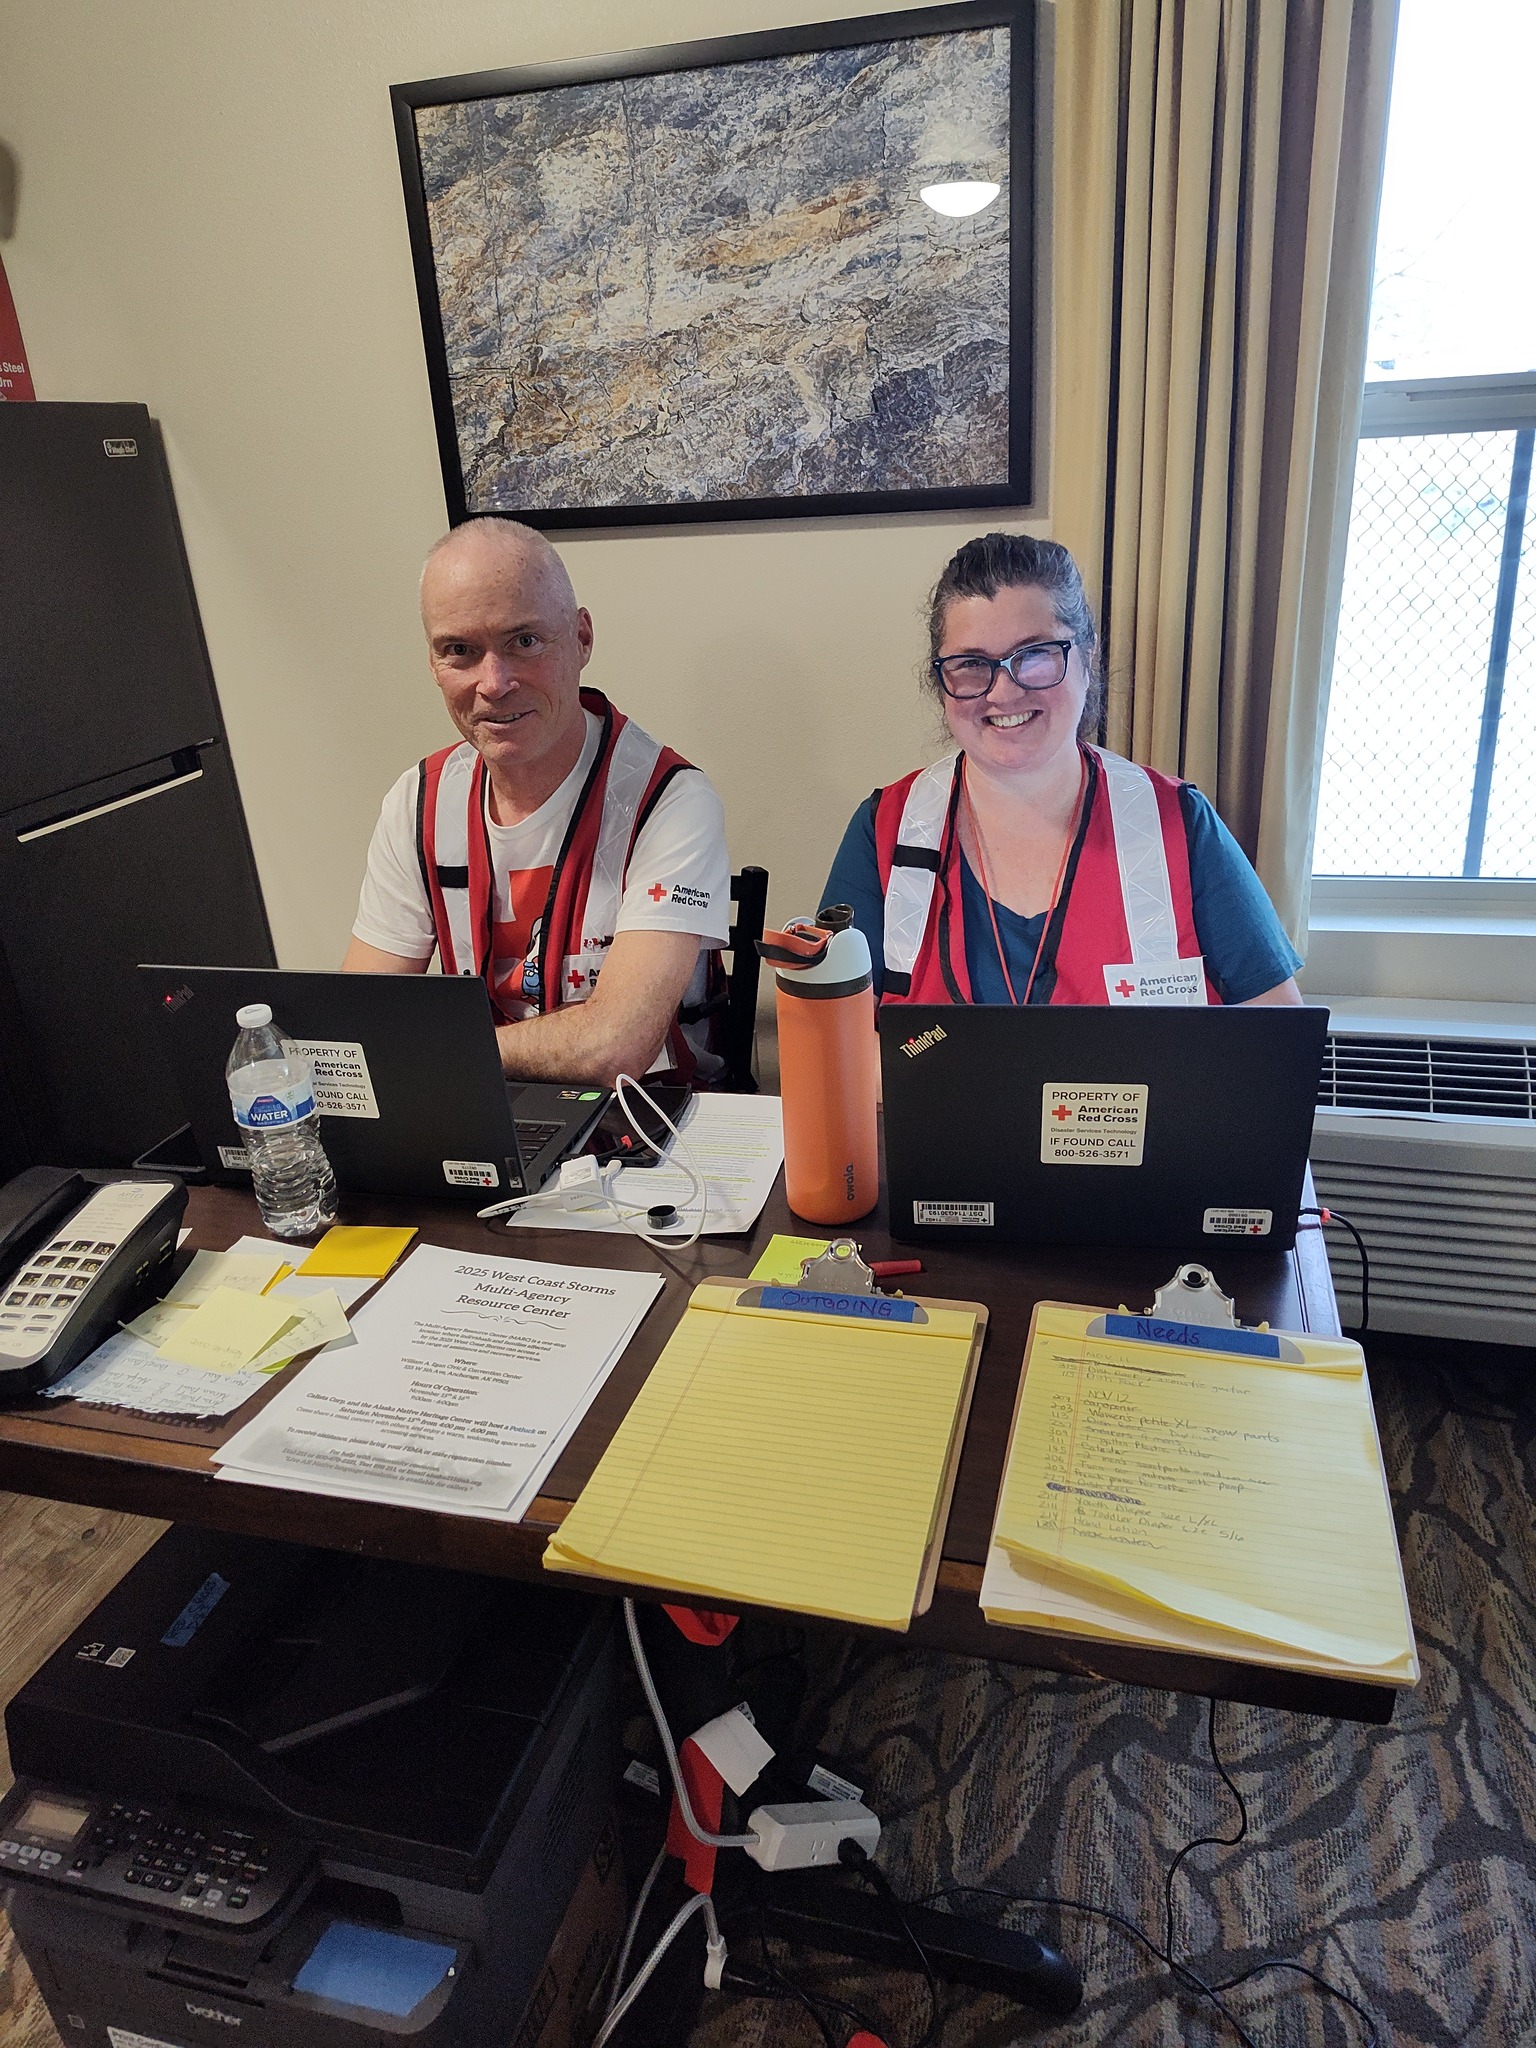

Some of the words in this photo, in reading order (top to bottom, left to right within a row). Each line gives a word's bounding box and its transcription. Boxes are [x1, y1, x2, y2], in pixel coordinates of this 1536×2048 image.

[2, 362, 25, 373] Steel
[672, 884, 711, 900] American
[671, 894, 687, 906] Red
[688, 897, 709, 909] Cross
[1139, 973, 1199, 987] American
[1140, 987, 1162, 998] Red
[1164, 984, 1199, 996] Cross
[900, 1024, 948, 1059] ThinkPad
[289, 1047, 340, 1058] PROPERTY
[344, 1050, 357, 1058] OF
[314, 1060, 361, 1070] American
[335, 1070, 363, 1078] Cross
[316, 1090, 344, 1099] OUND
[346, 1092, 369, 1101] CALL
[1052, 1092, 1119, 1101] PROPERTY
[1122, 1093, 1140, 1101] OF
[317, 1101, 367, 1111] 0-526-3571
[1078, 1105, 1139, 1114] American
[251, 1110, 288, 1122] WATER
[1078, 1114, 1100, 1122] Red
[1103, 1115, 1138, 1123] Cross
[1063, 1138, 1104, 1146] FOUND
[1107, 1139, 1136, 1147] CALL
[1054, 1149, 1129, 1158] 800-526-3571
[846, 1164, 855, 1201] owala
[454, 1265, 489, 1278] 2025
[491, 1270, 525, 1283] West
[527, 1276, 565, 1289] Coast
[566, 1281, 617, 1296] Storms
[473, 1282, 571, 1305] Multi-Agency
[456, 1294, 520, 1311] Resource
[522, 1304, 571, 1319] Center
[1136, 1321, 1200, 1344] Needs
[410, 1381, 433, 1389] Hours
[306, 1392, 329, 1401] Calista
[371, 1404, 395, 1412] Alaska
[395, 1407, 419, 1415] Native
[419, 1410, 449, 1421] Heritage
[449, 1416, 473, 1424] Center
[488, 1421, 504, 1429] host
[509, 1425, 536, 1435] Potluck
[370, 1411, 407, 1421] November
[1202, 1427, 1238, 1437] snow
[1243, 1432, 1280, 1443] pants
[186, 2002, 241, 2027] brother
